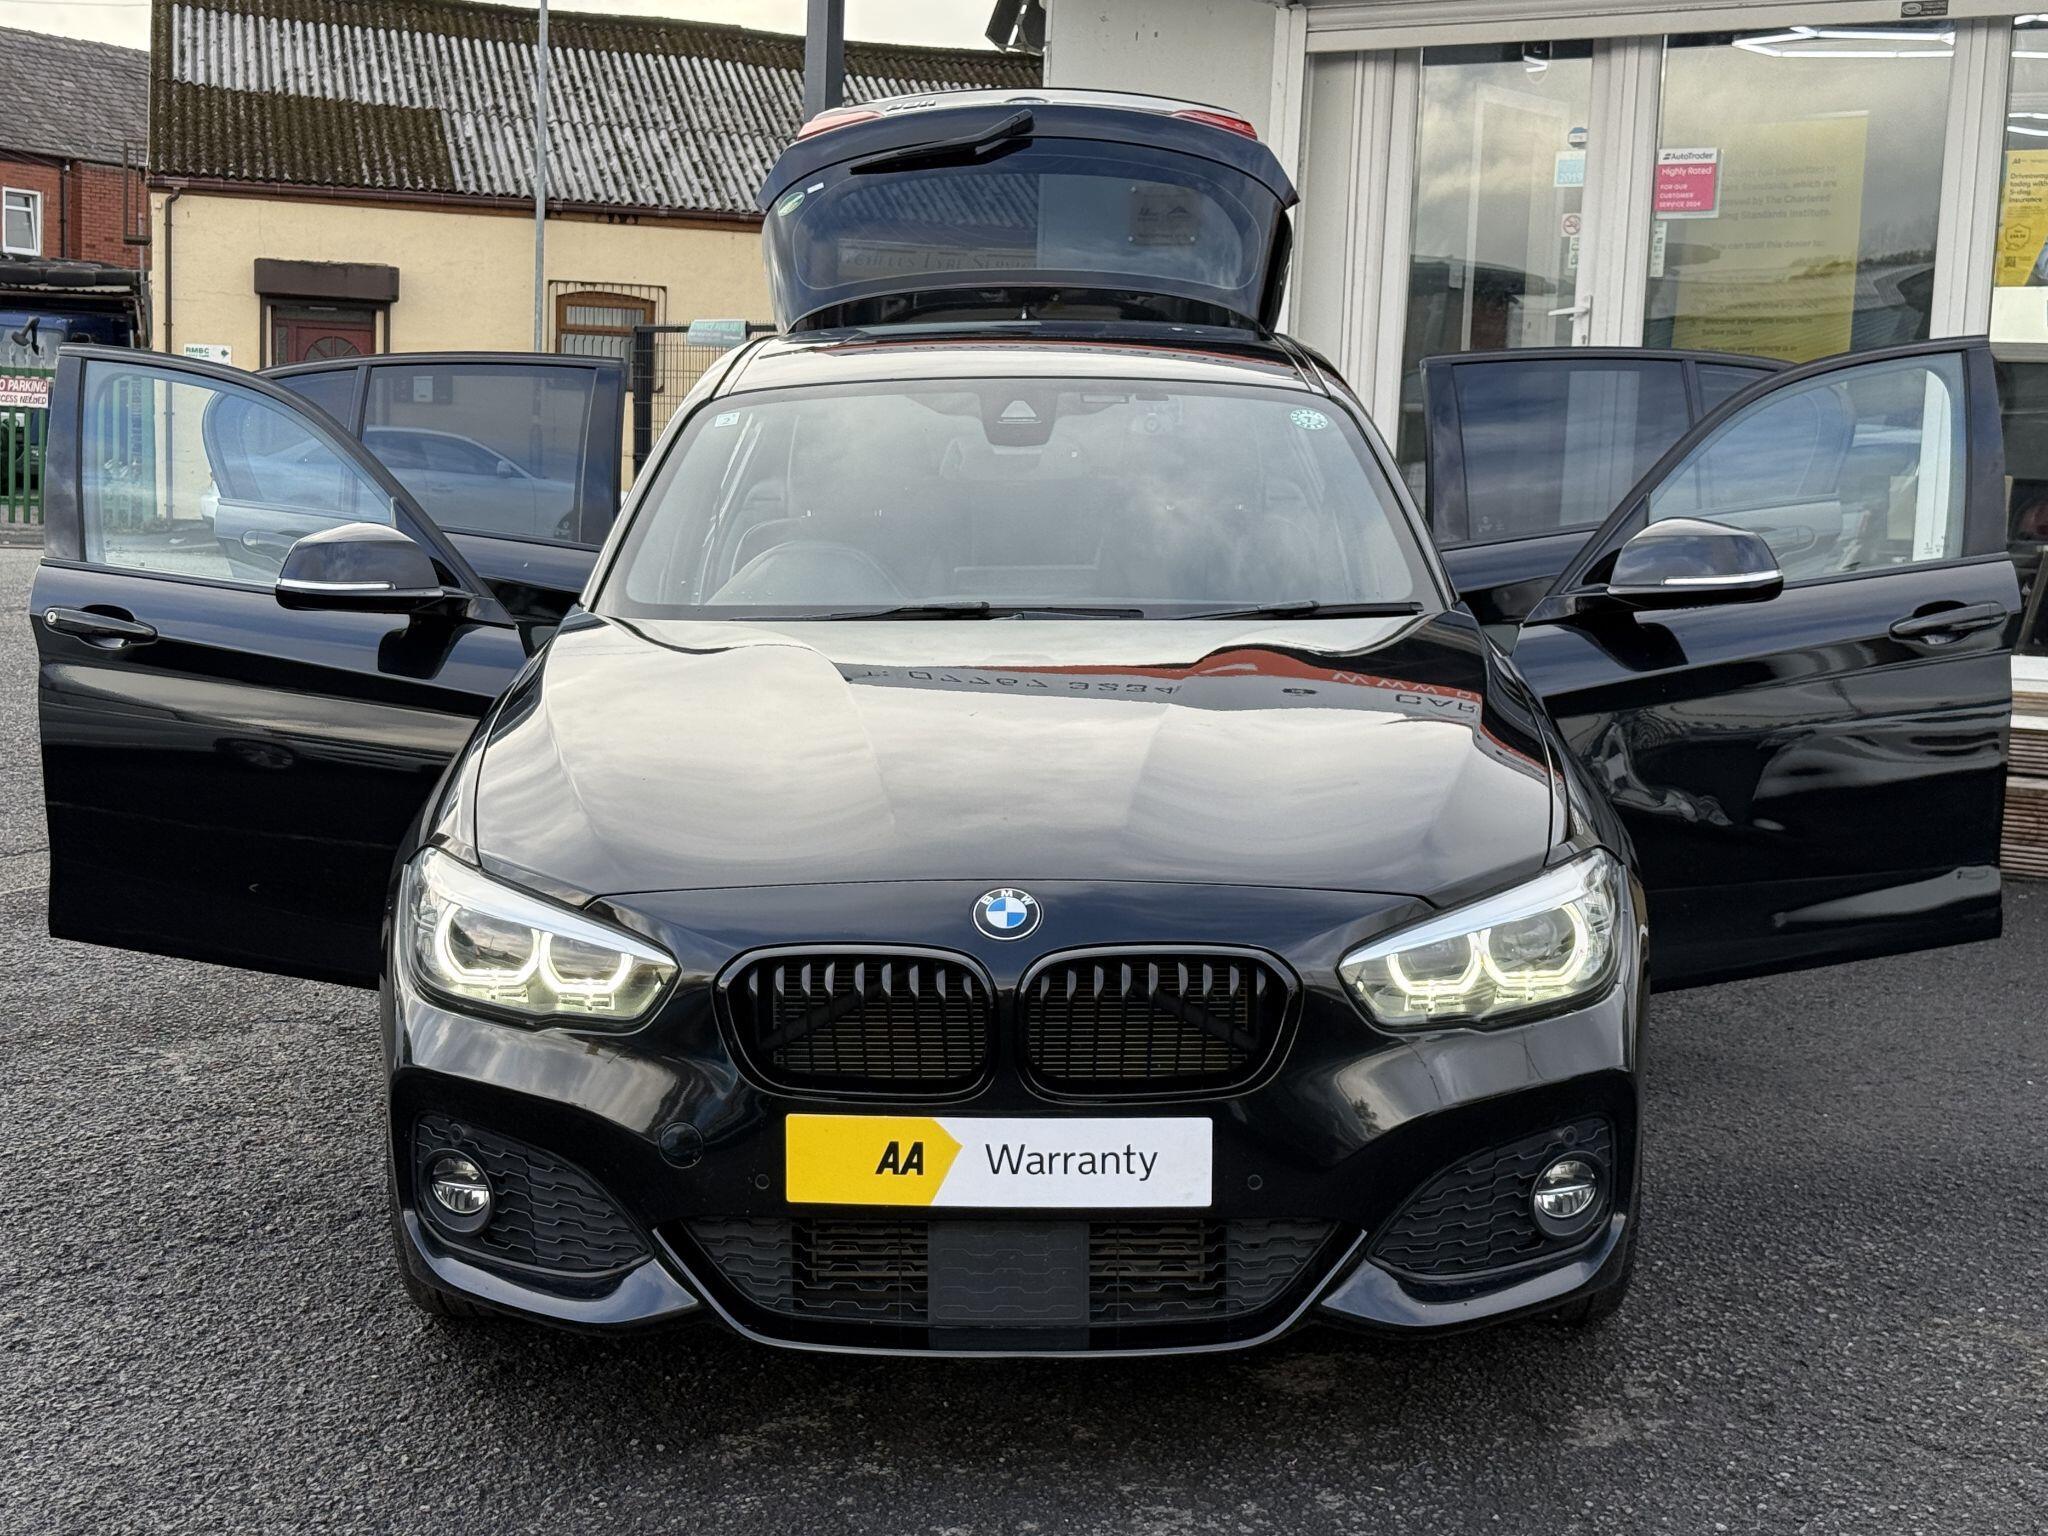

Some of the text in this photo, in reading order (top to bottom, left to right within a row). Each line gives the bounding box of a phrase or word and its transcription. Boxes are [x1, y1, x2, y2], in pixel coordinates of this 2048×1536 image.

[1671, 152, 1714, 162] AutoTrader
[1661, 166, 1712, 178] Highly Rated
[7, 379, 47, 392] PARKING
[0, 394, 18, 403] CESS
[980, 889, 1035, 906] BMW
[875, 1141, 1159, 1181] AA Warranty
